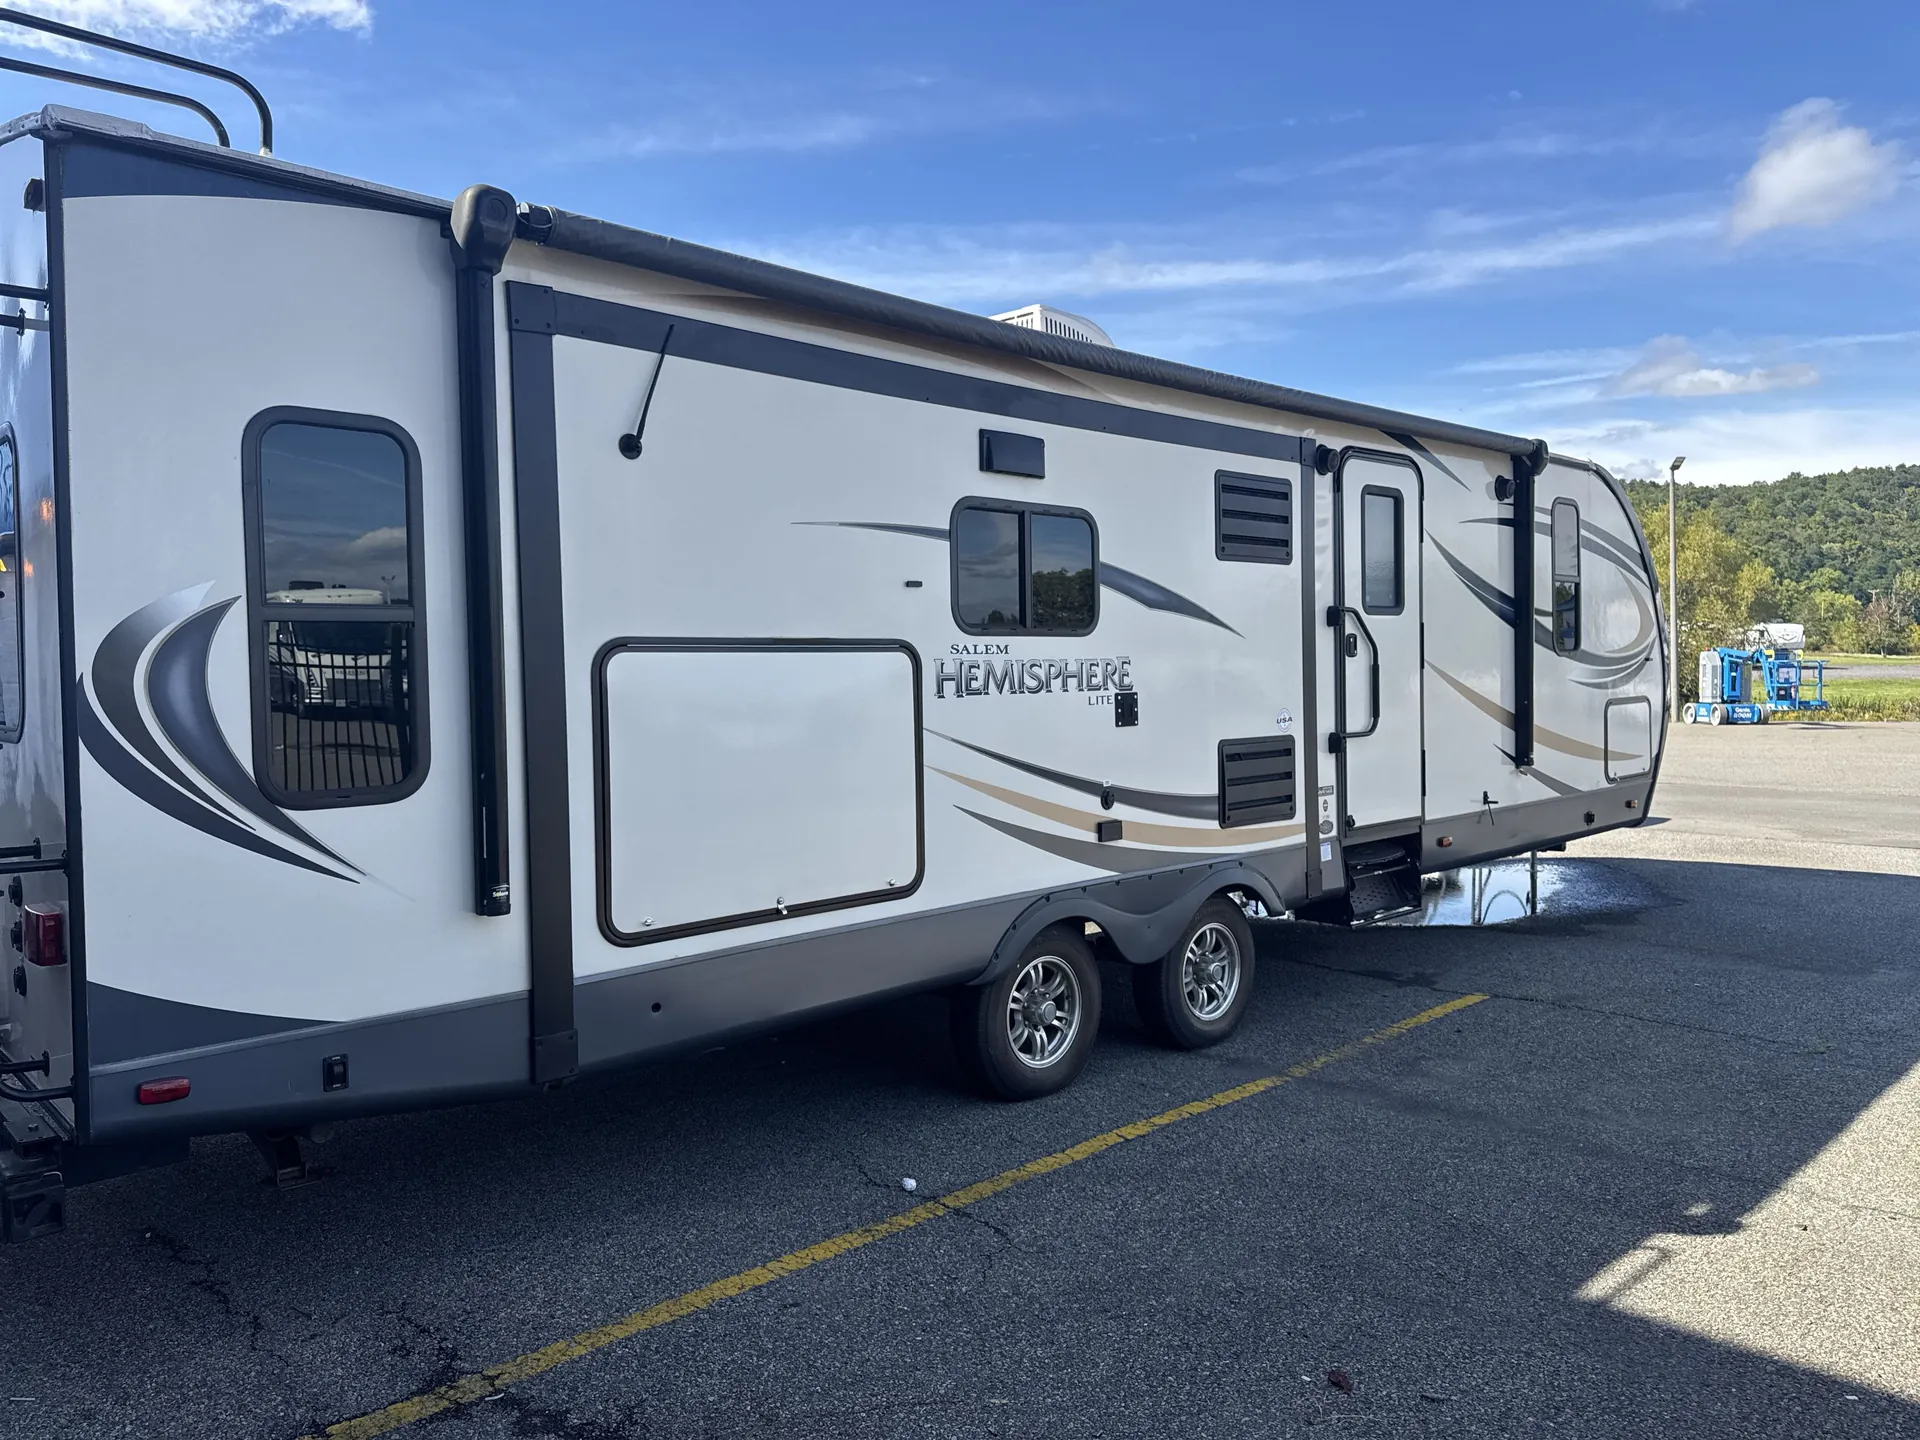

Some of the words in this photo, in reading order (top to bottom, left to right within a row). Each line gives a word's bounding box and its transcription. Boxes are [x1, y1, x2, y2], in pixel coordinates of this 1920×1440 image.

[950, 644, 1010, 655] SALEM
[933, 656, 1134, 699] HEMISPHERE
[1088, 695, 1114, 706] LITE
[1276, 716, 1293, 725] USA
